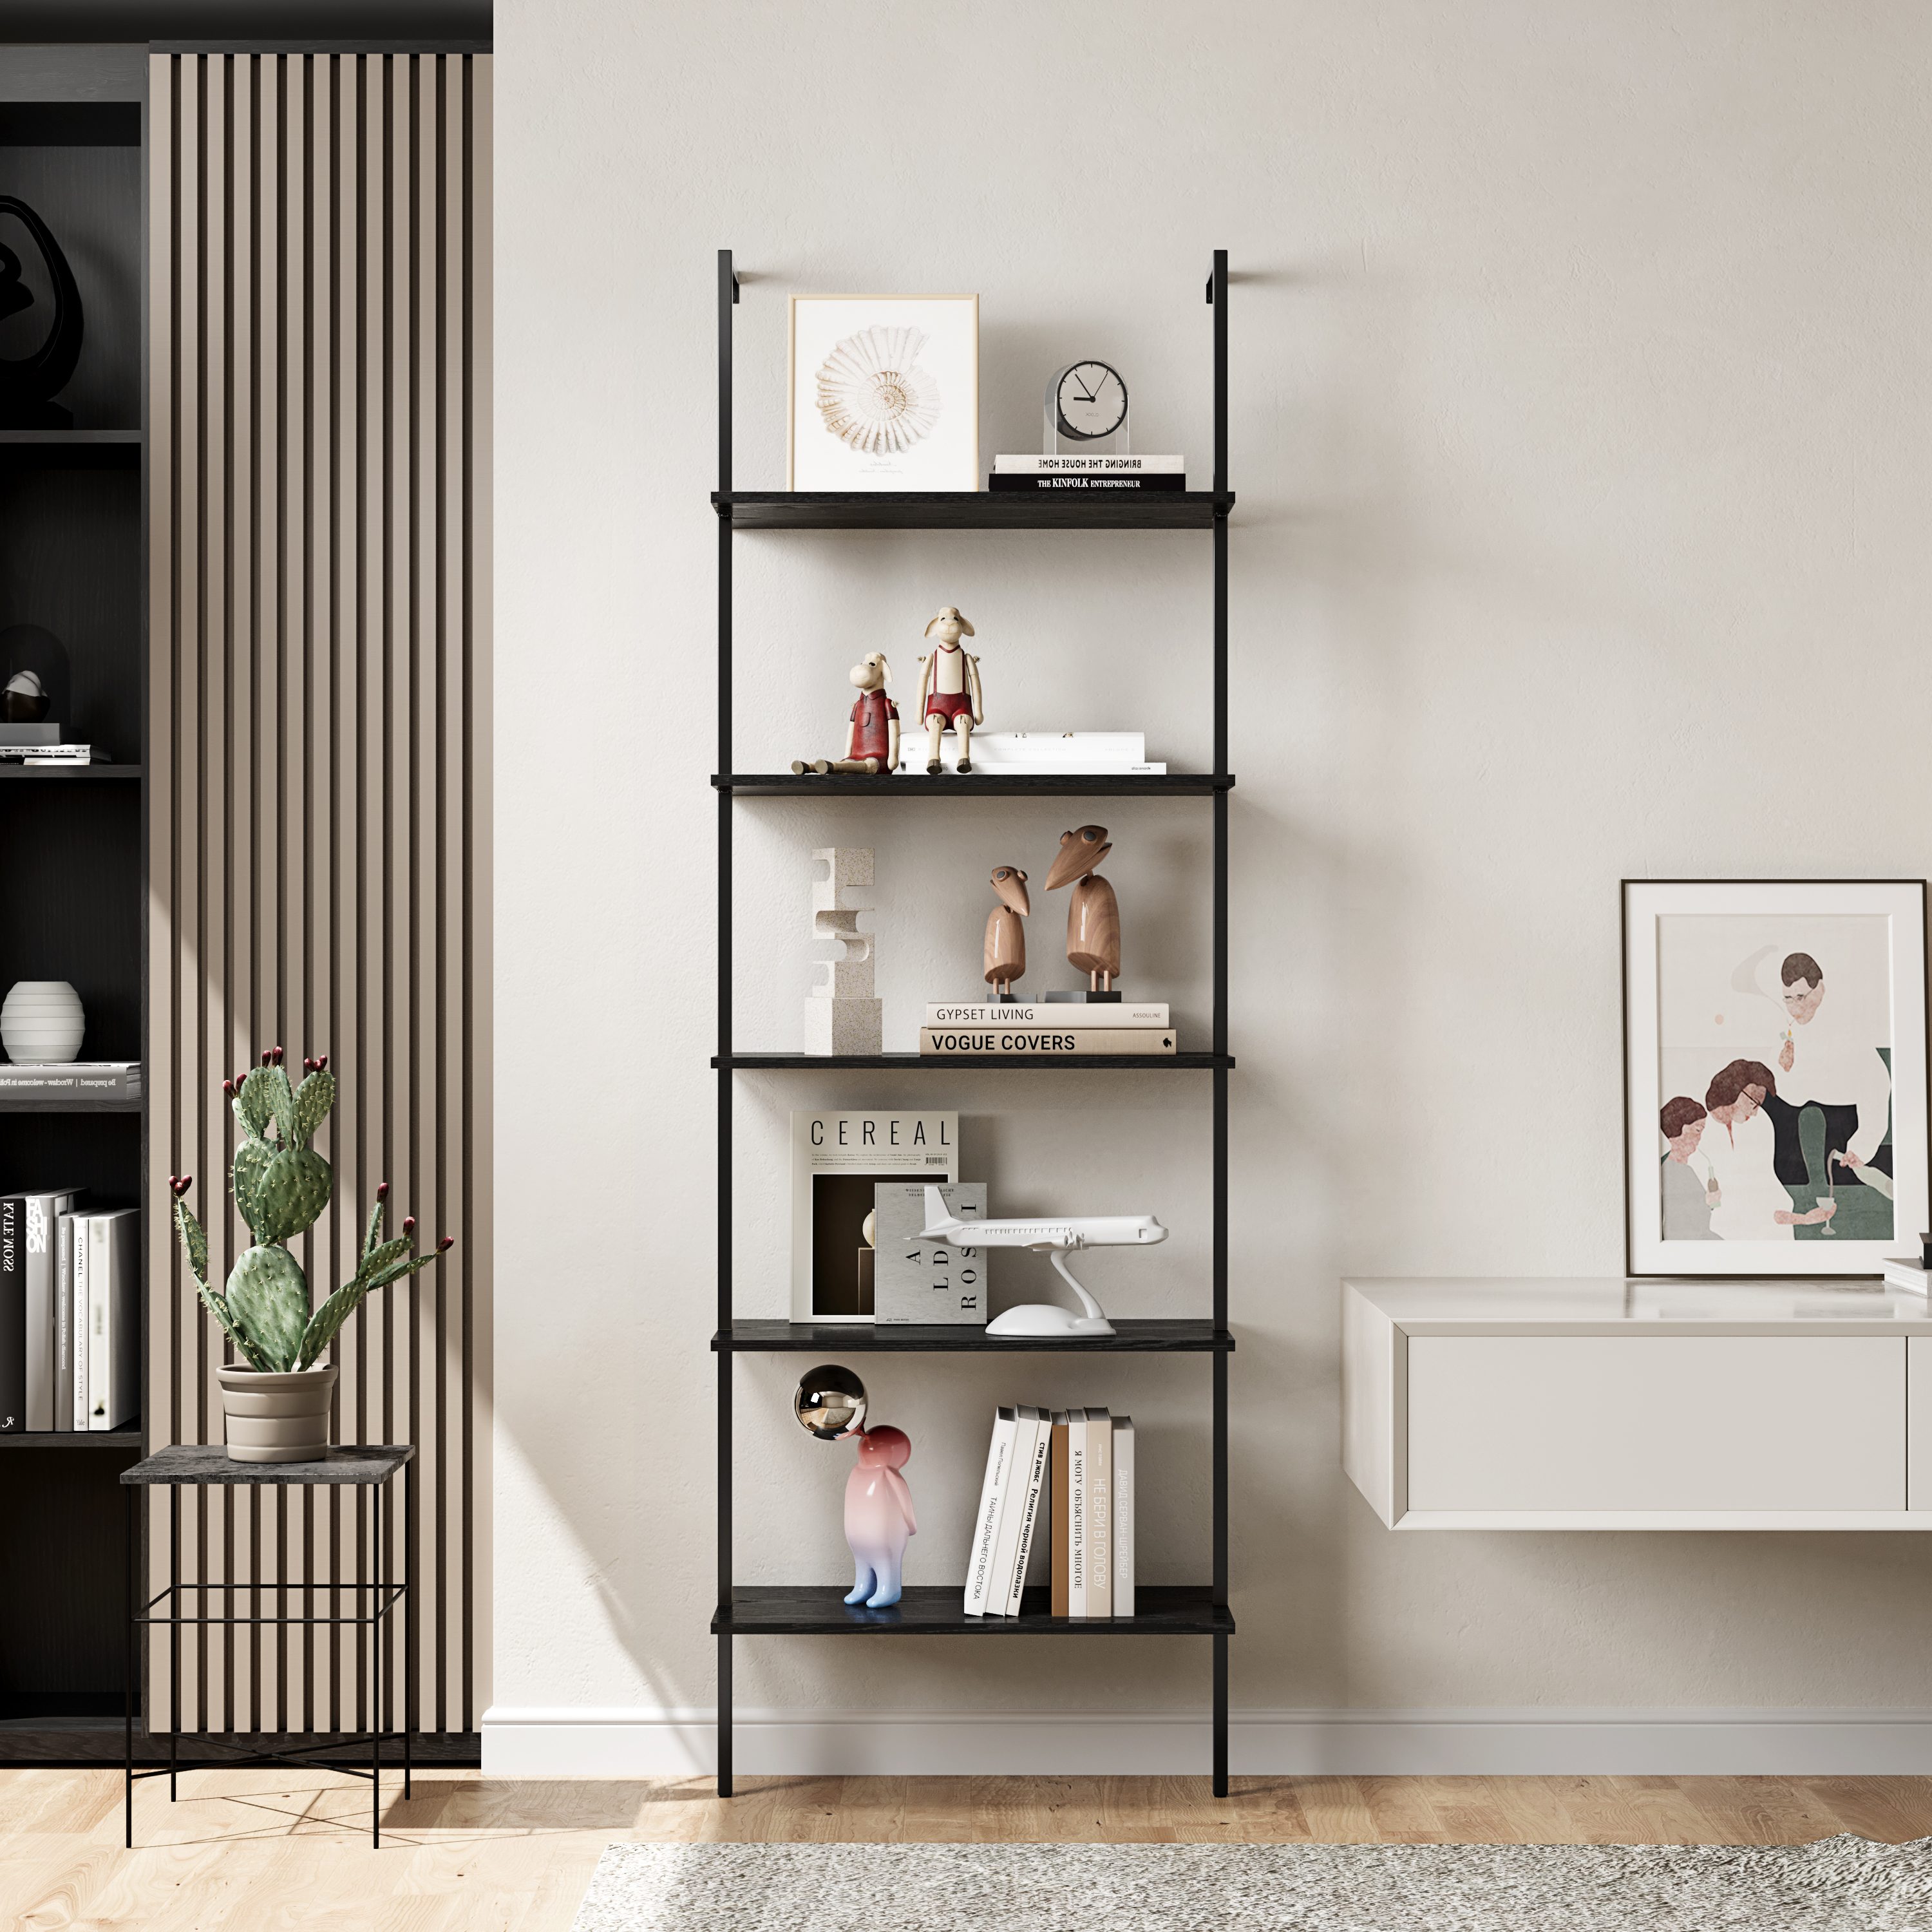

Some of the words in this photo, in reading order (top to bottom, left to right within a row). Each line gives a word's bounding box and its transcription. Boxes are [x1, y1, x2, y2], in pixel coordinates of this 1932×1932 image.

[1052, 478, 1088, 488] KINFOLK
[936, 1009, 985, 1020] GYPSET
[990, 1009, 1034, 1020] LIVING
[931, 1035, 995, 1050] VOGUE
[1001, 1035, 1075, 1050] COVERS
[811, 1120, 951, 1146] CEREAL
[26, 1198, 44, 1217] FA
[26, 1216, 48, 1235] SHI
[26, 1235, 46, 1253] ON
[905, 1249, 921, 1265] A
[961, 1204, 976, 1311] ROSI
[933, 1250, 949, 1291] LD
[78, 1361, 83, 1372] OF
[1094, 1479, 1106, 1493] НЕ
[1117, 1469, 1128, 1499] ДАВИД
[1027, 1488, 1038, 1522] Религия
[1094, 1497, 1106, 1527] БЕРИ
[980, 1523, 992, 1563] ДАЛЬНЕГО
[1021, 1524, 1030, 1553] черной
[1119, 1500, 1129, 1578] СЕРВАН-ШРЕЙБЕР
[1012, 1555, 1025, 1598] водолазки
[1094, 1542, 1106, 1589] ГОЛОВУ
[973, 1564, 985, 1600] ВОСТОКА
